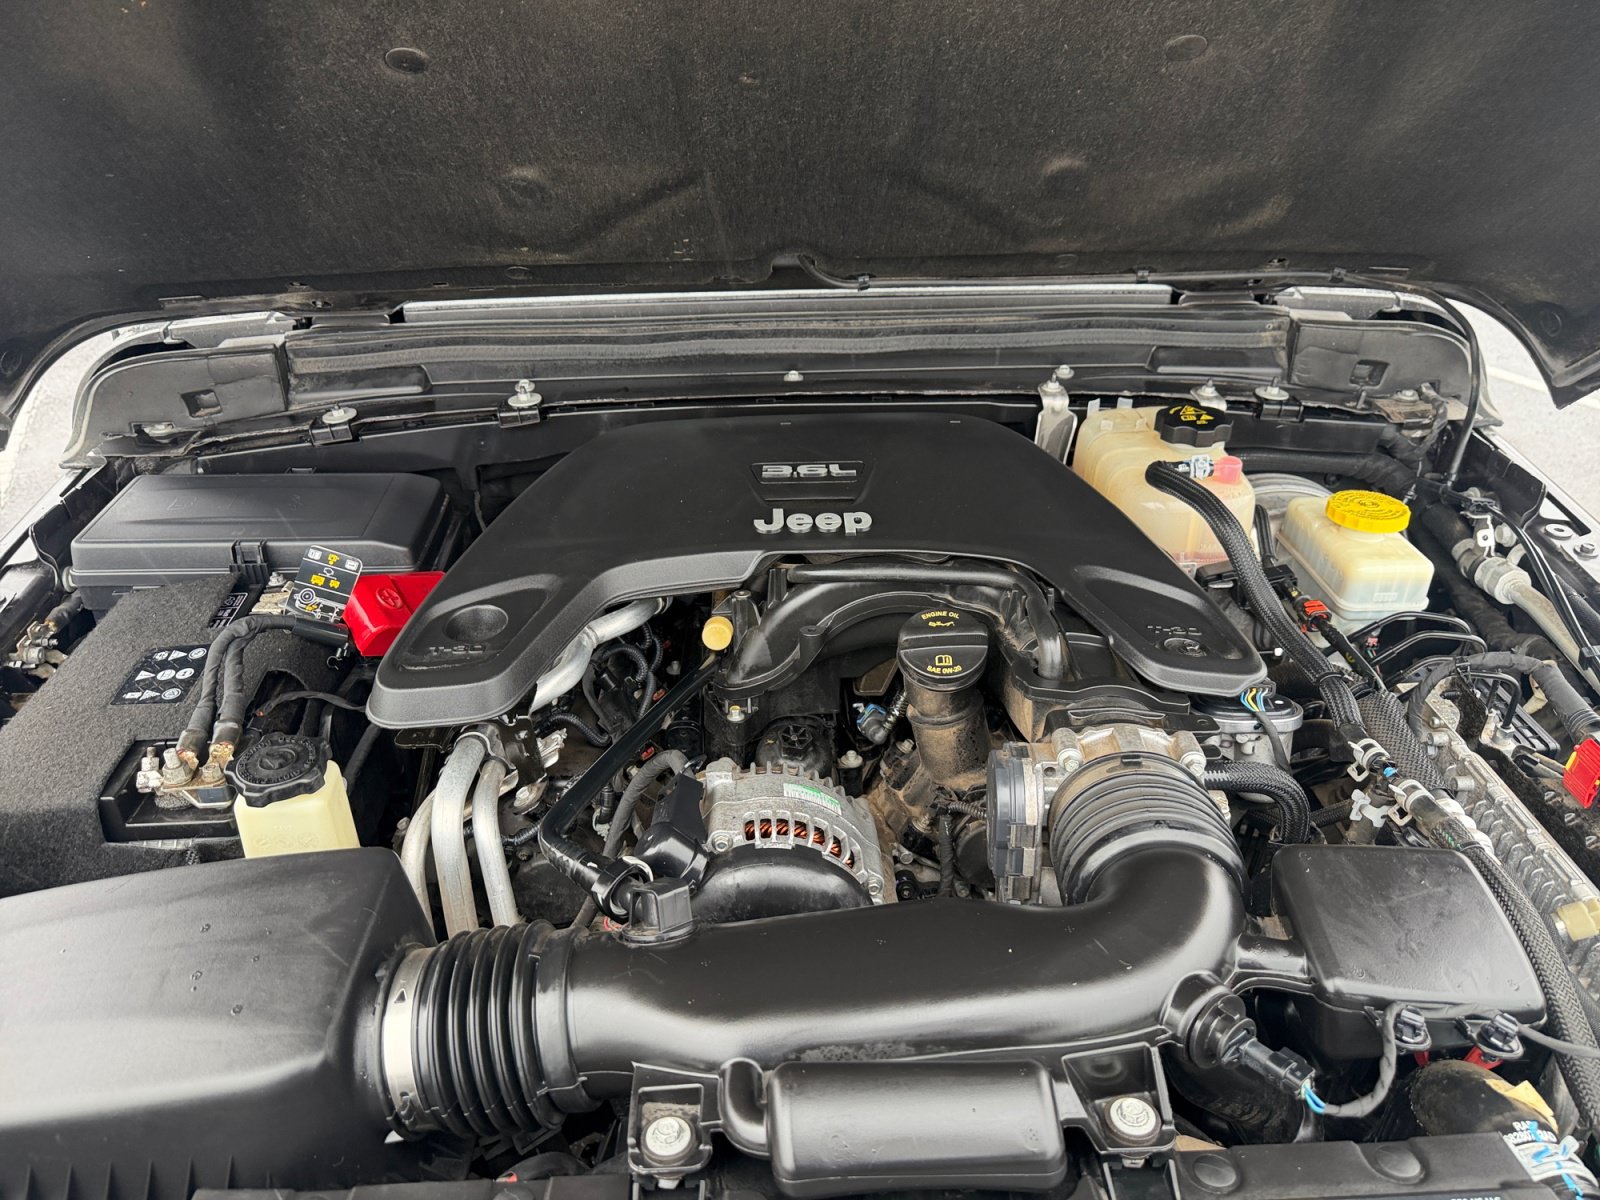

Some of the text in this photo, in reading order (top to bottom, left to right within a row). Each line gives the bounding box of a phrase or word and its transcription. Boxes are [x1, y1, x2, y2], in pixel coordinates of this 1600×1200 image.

[762, 464, 857, 478] 3.6L
[754, 508, 873, 536] Jeep
[921, 611, 960, 620] ENGINE OIL
[927, 665, 962, 674] SAE 0W-20
[1512, 1120, 1538, 1132] RA
